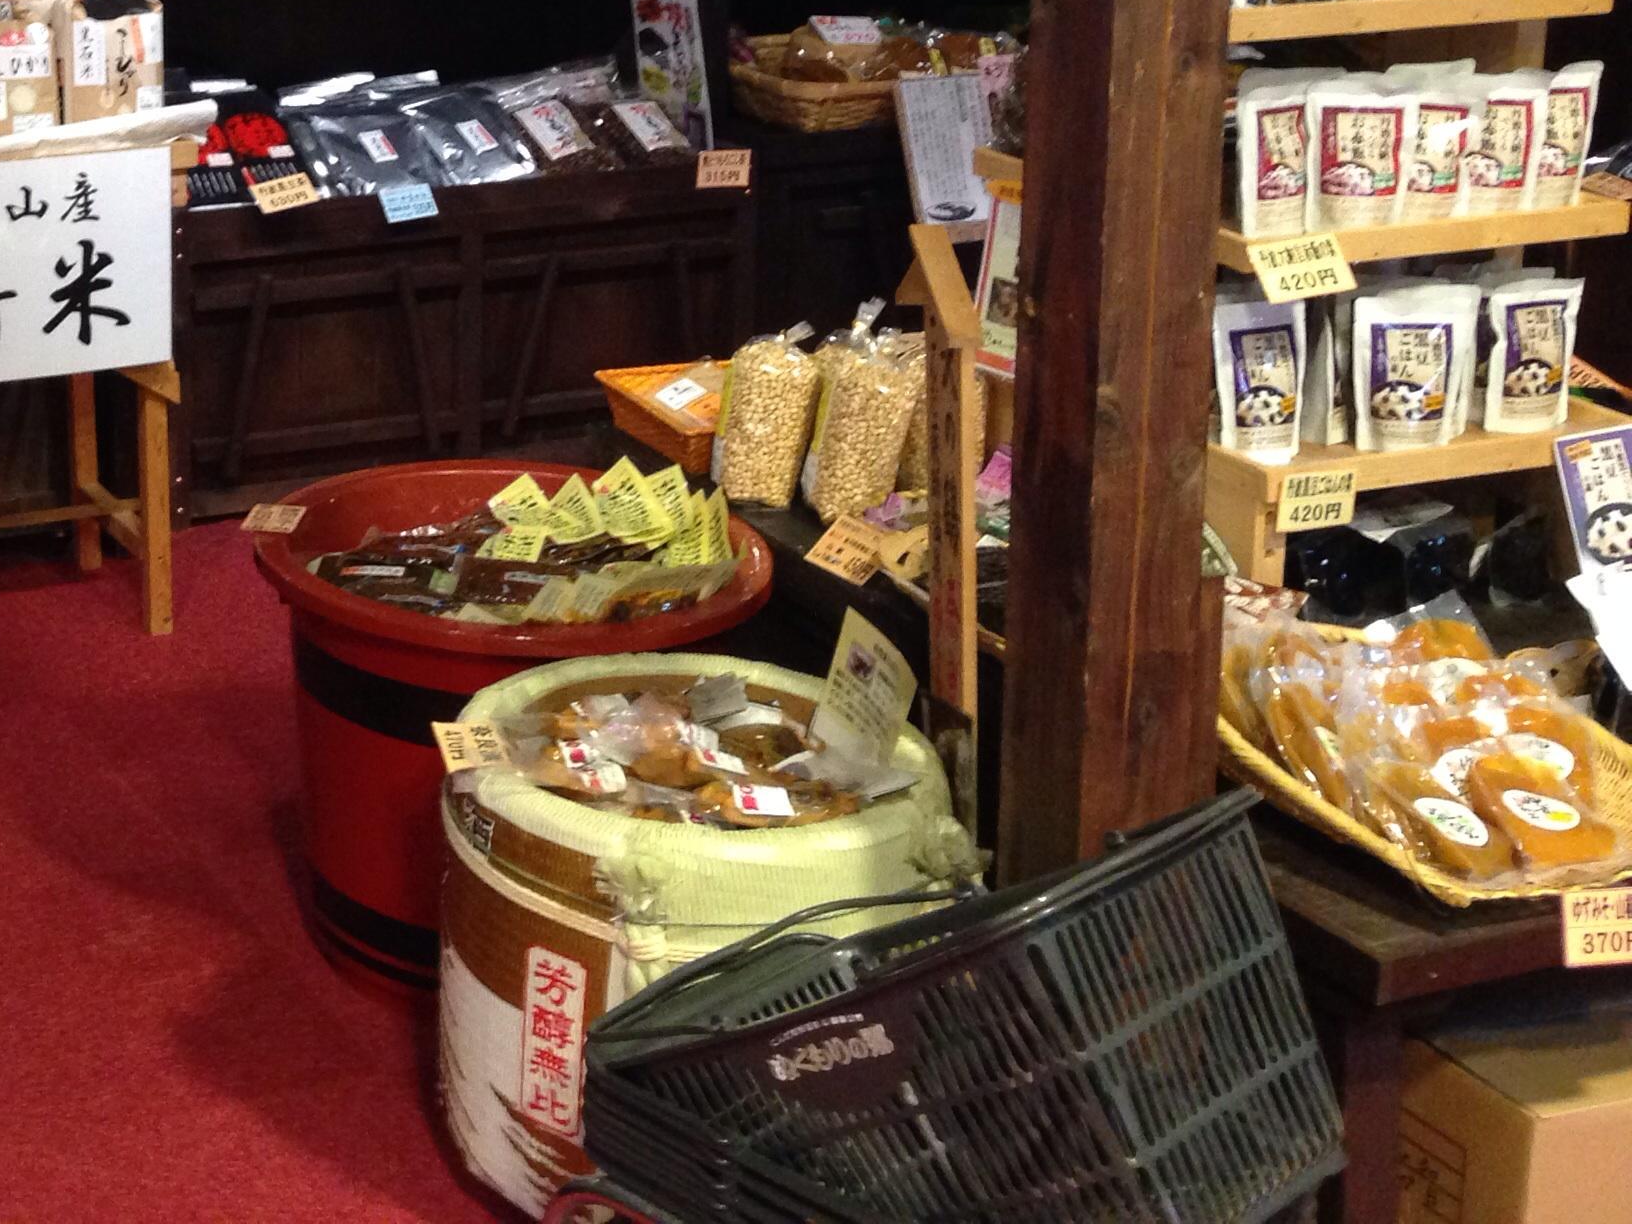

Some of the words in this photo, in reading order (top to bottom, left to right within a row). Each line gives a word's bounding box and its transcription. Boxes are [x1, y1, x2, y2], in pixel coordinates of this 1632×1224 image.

[1279, 267, 1338, 292] 420円
[1289, 502, 1342, 522] 420円
[531, 959, 579, 1129] 芳醇無比
